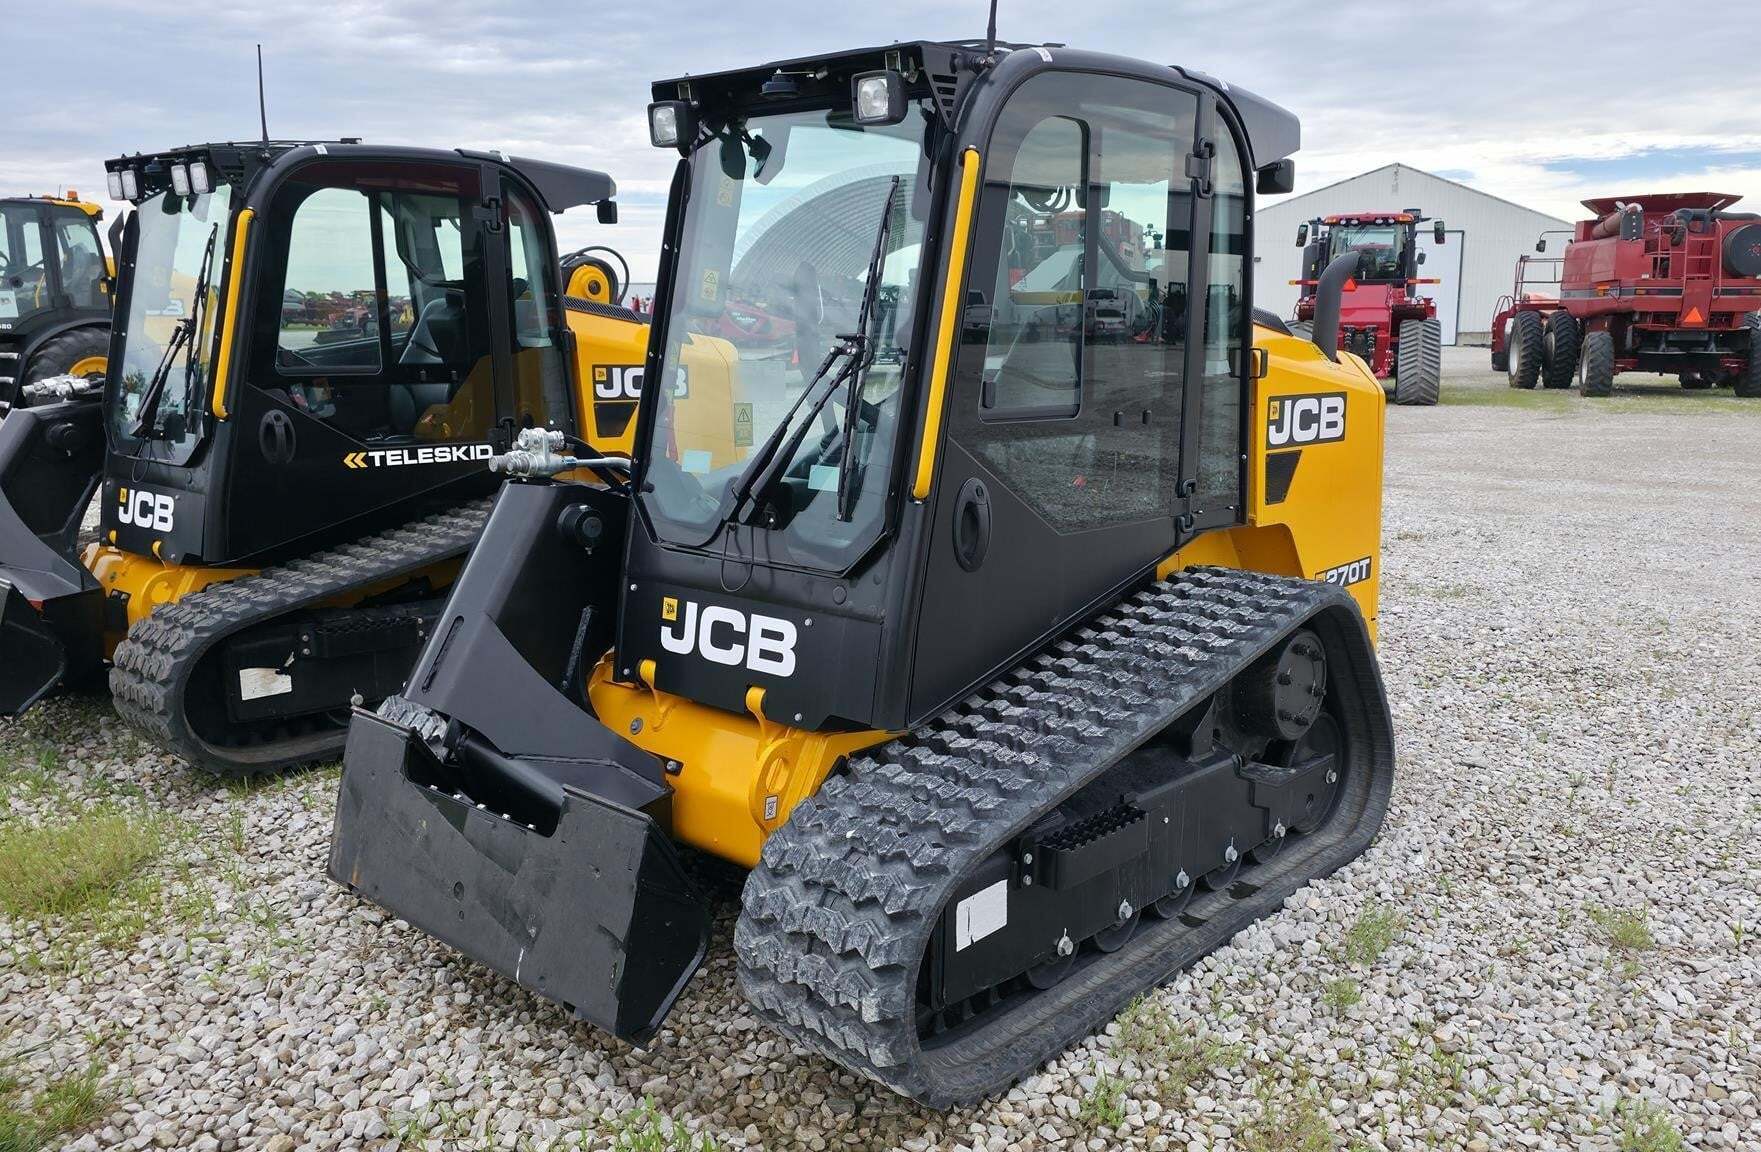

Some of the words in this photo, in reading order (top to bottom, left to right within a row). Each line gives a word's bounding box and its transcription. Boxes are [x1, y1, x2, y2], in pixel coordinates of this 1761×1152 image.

[1269, 396, 1345, 445] JCB
[368, 444, 494, 467] TELESKID
[118, 489, 174, 533] JCB
[1326, 558, 1371, 587] 270T
[660, 601, 798, 678] JCB
